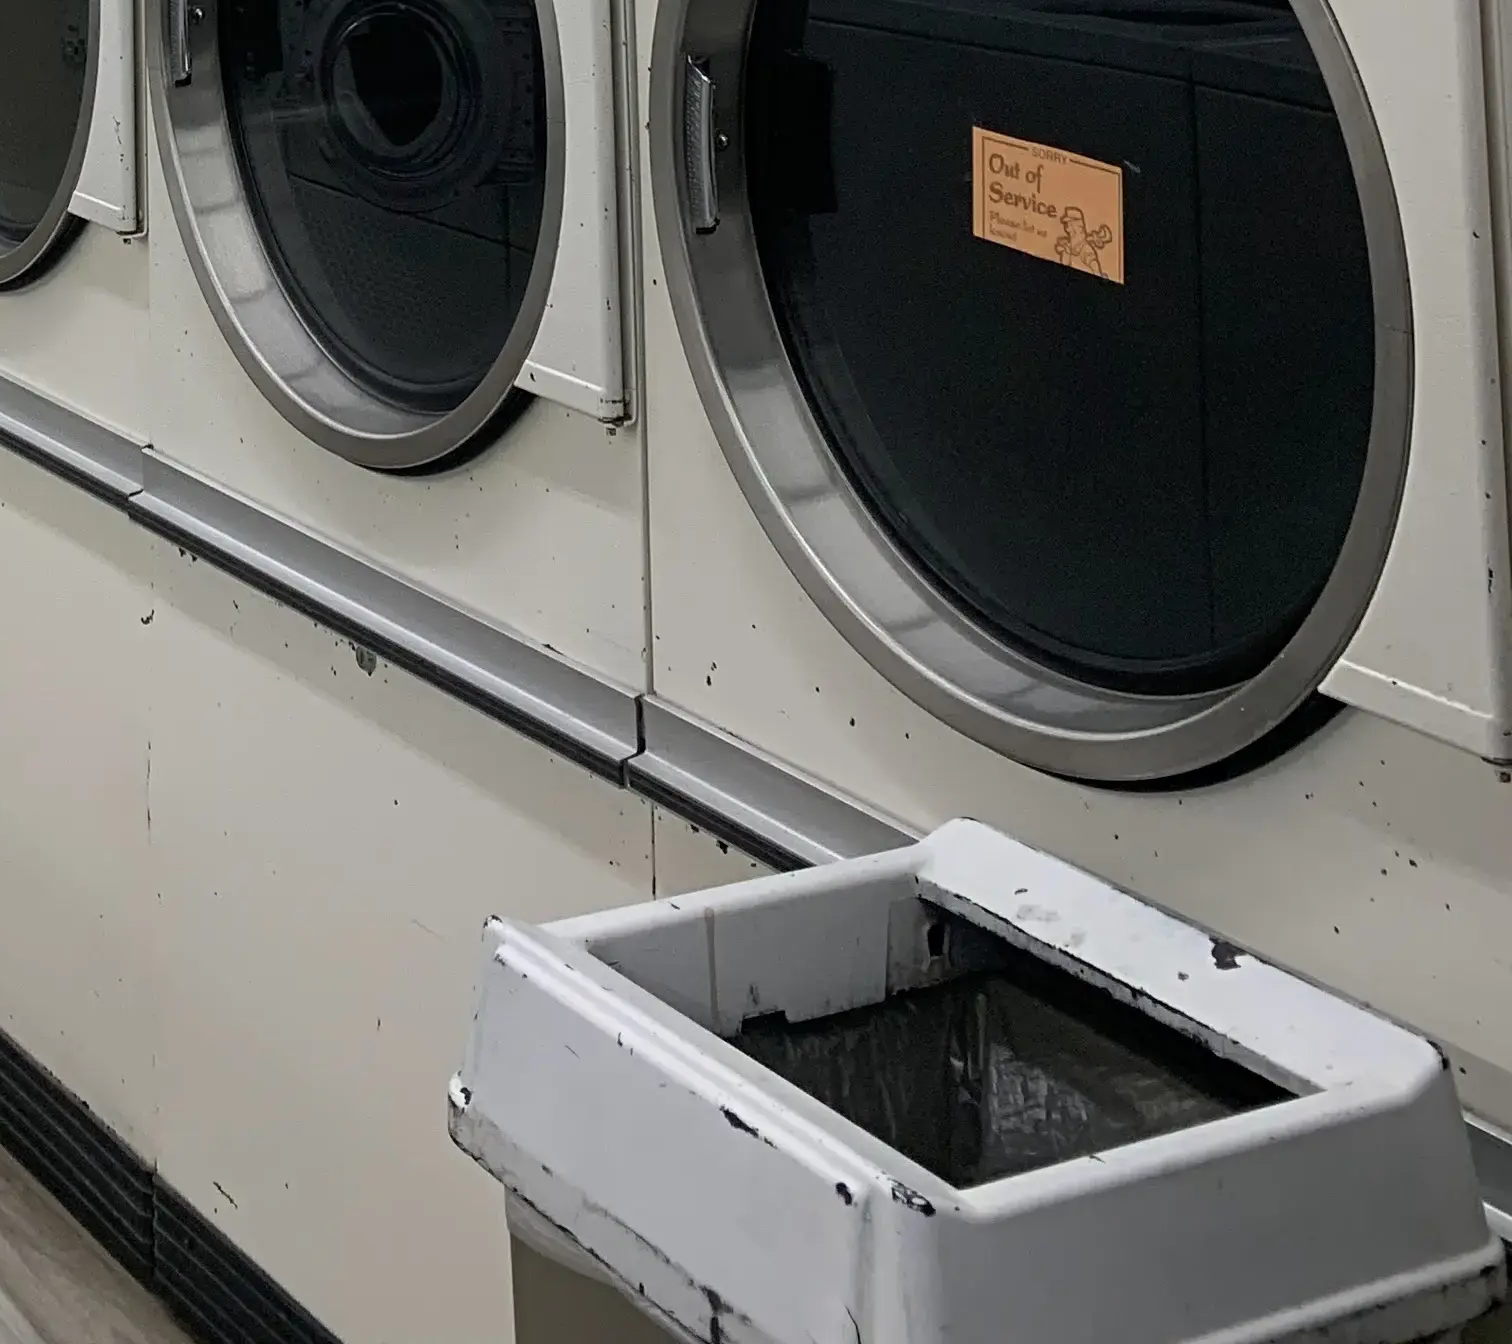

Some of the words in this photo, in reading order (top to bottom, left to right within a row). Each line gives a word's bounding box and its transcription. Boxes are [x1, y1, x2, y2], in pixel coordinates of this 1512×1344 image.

[1031, 145, 1069, 164] SORRY
[989, 153, 1021, 180] Out
[1025, 163, 1044, 194] of
[989, 182, 1057, 219] Service
